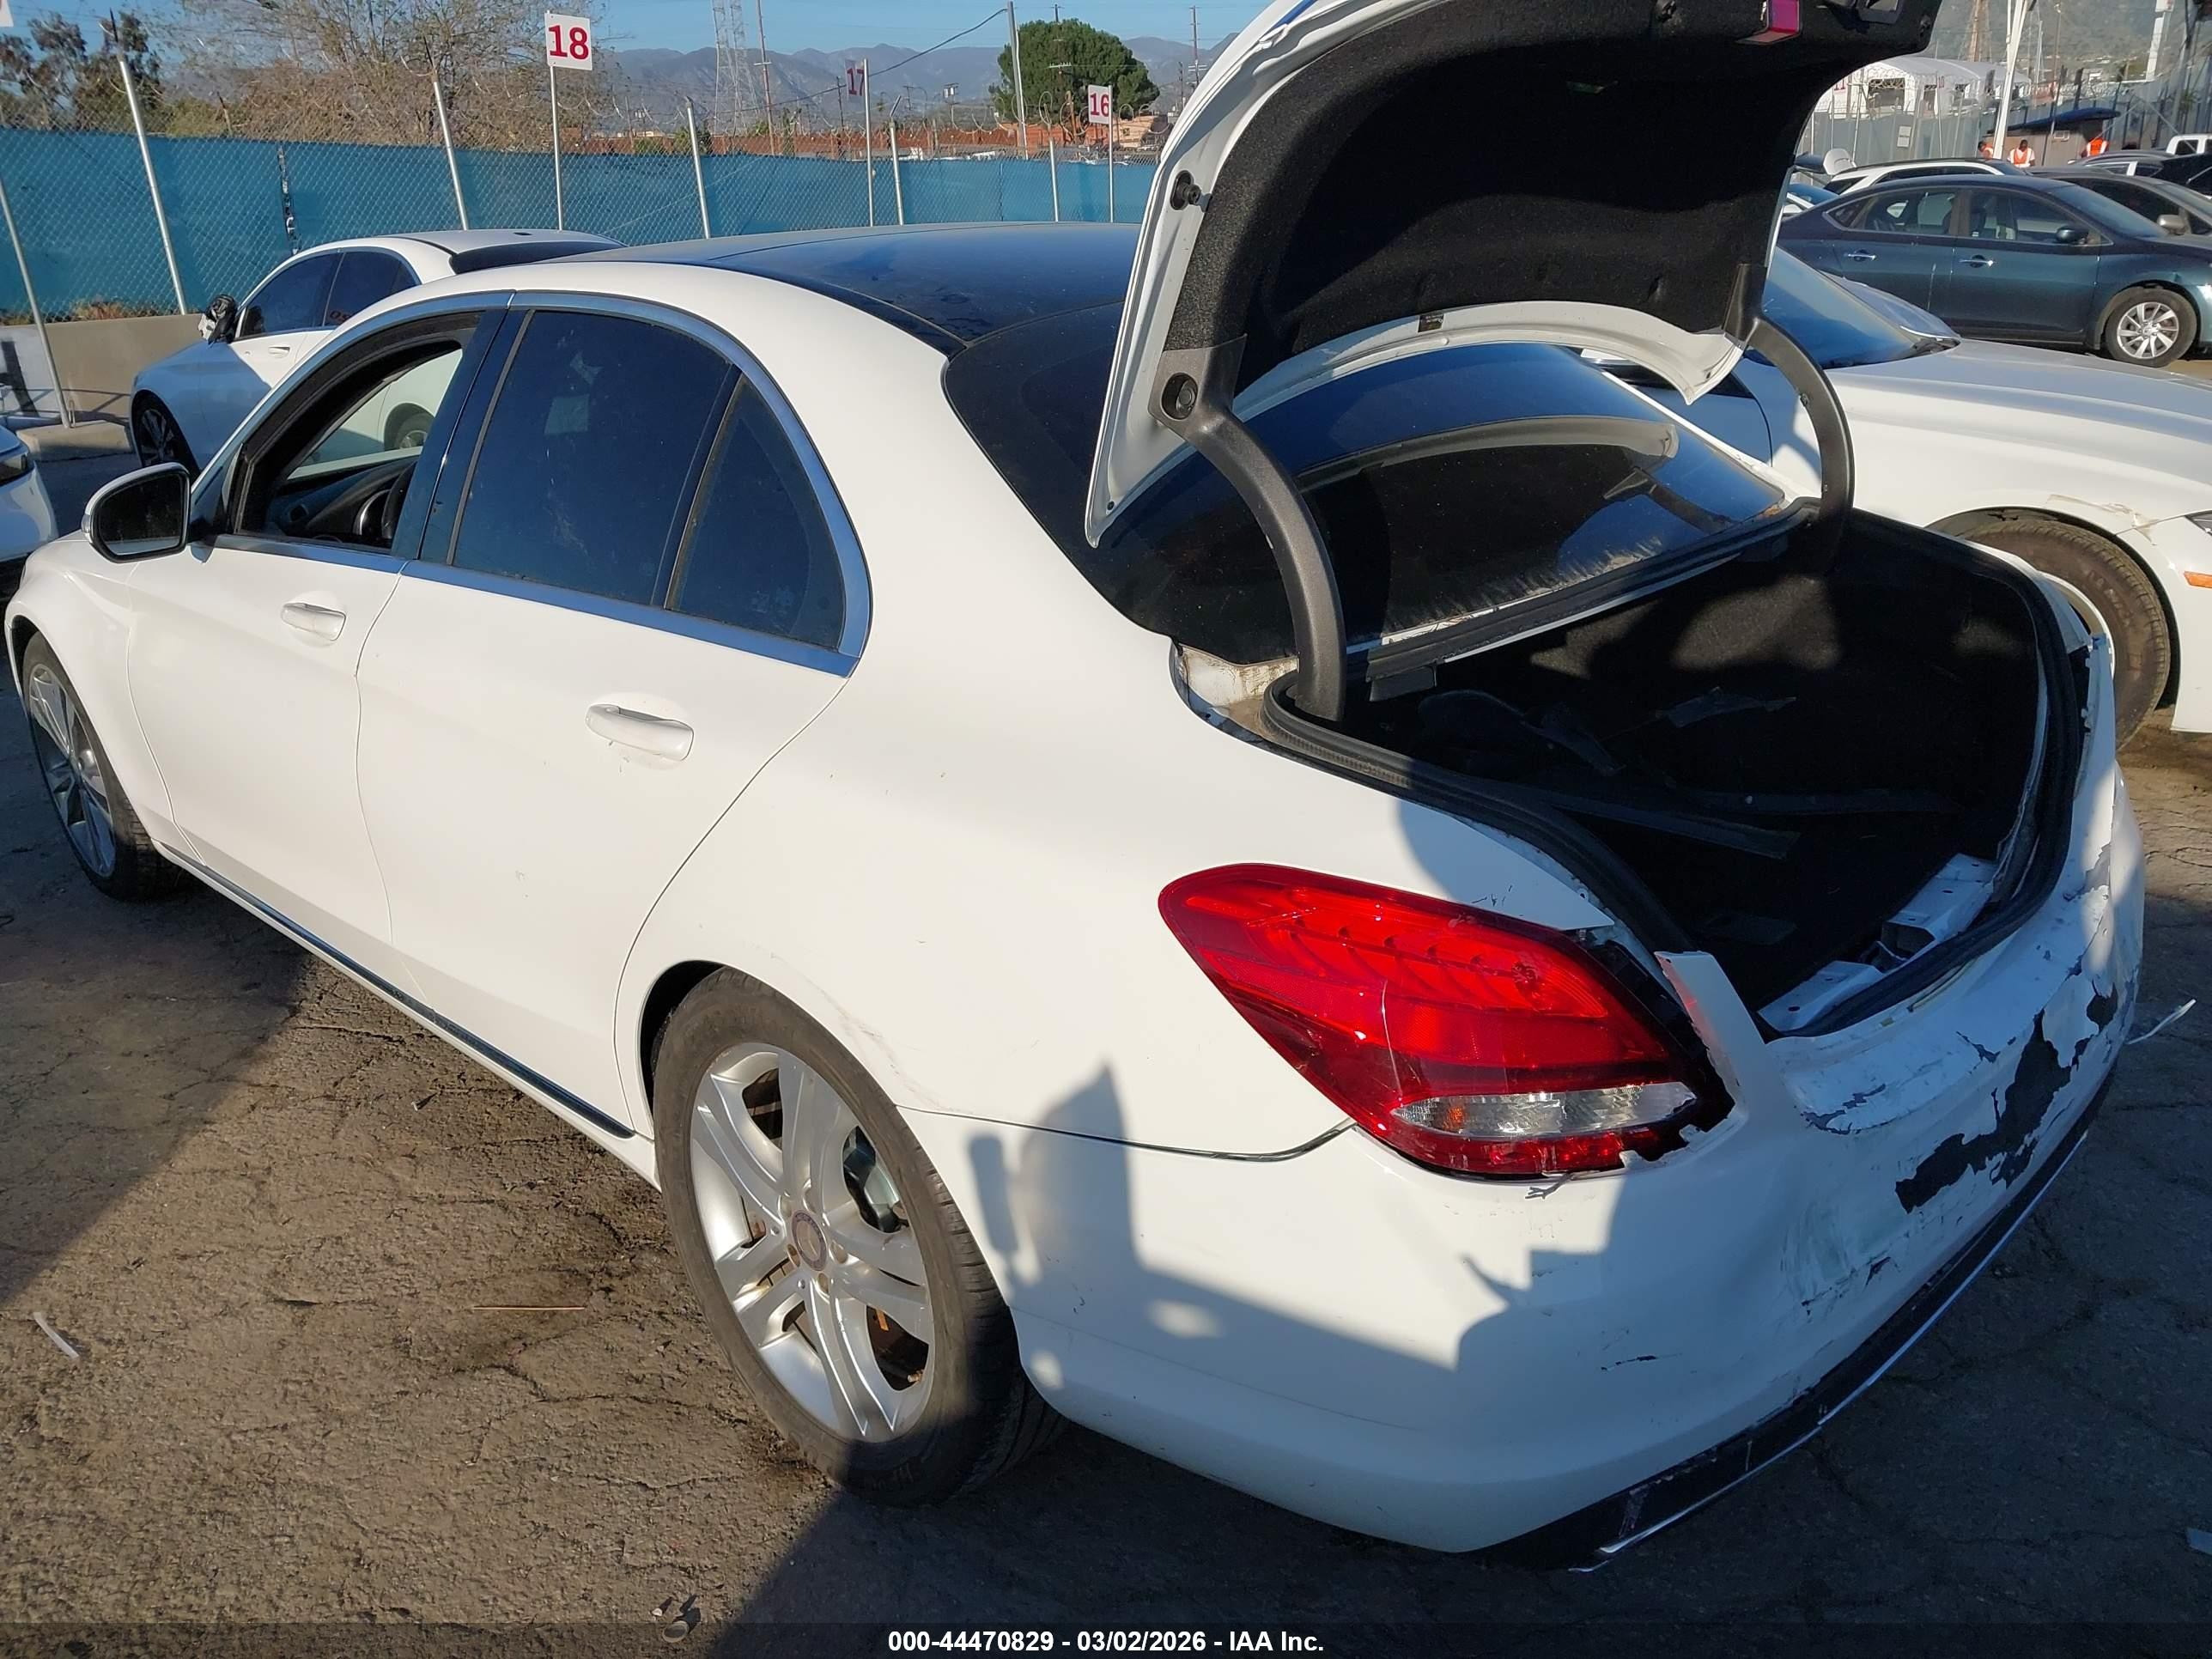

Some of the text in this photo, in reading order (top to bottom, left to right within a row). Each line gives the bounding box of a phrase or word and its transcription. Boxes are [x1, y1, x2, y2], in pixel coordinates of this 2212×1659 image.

[548, 25, 589, 60] 18
[847, 68, 865, 96] 17
[1090, 93, 1109, 118] 16
